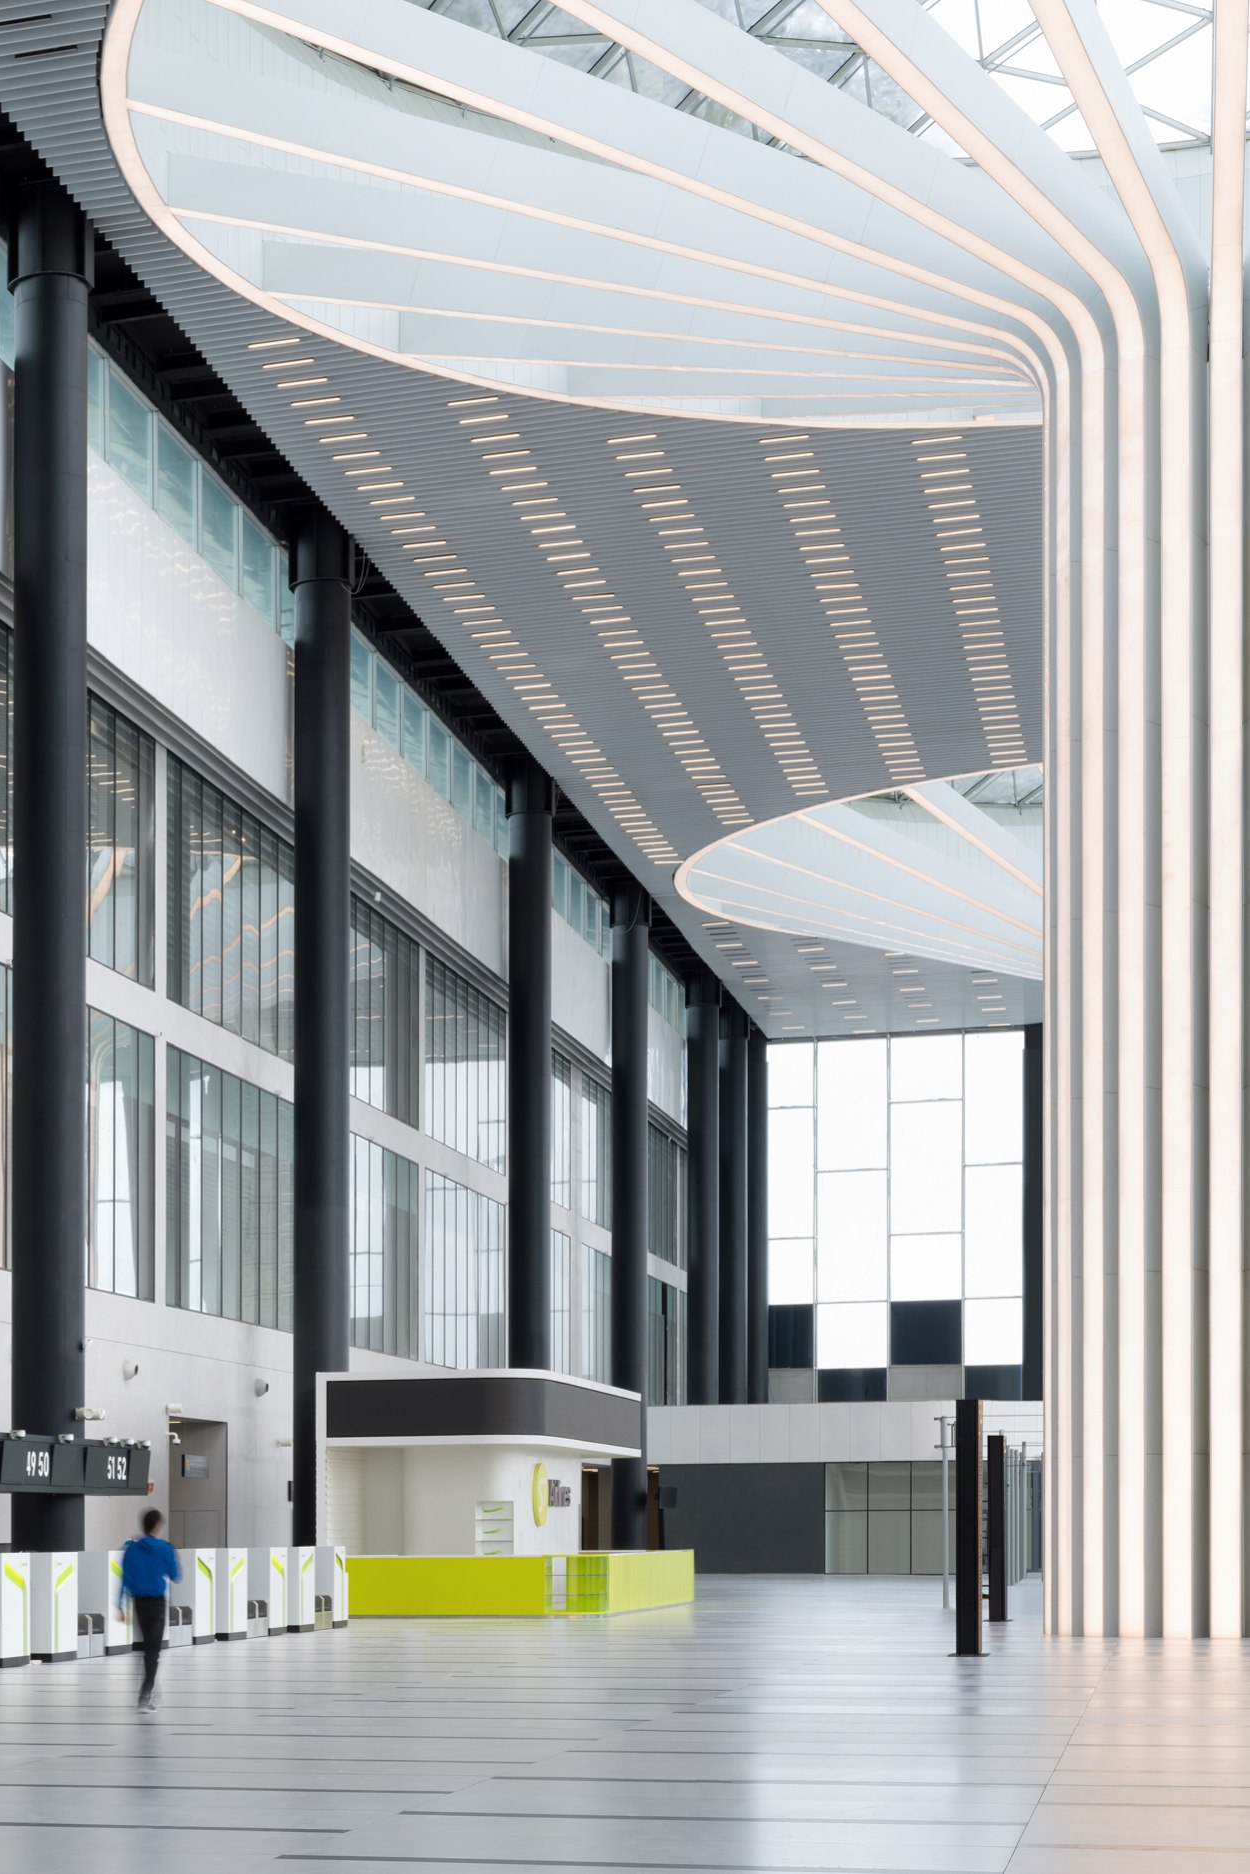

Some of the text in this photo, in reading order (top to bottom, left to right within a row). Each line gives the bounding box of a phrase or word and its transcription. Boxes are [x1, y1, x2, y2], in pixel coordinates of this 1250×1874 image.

[26, 1451, 49, 1477] 49 50
[107, 1456, 126, 1480] 51 52
